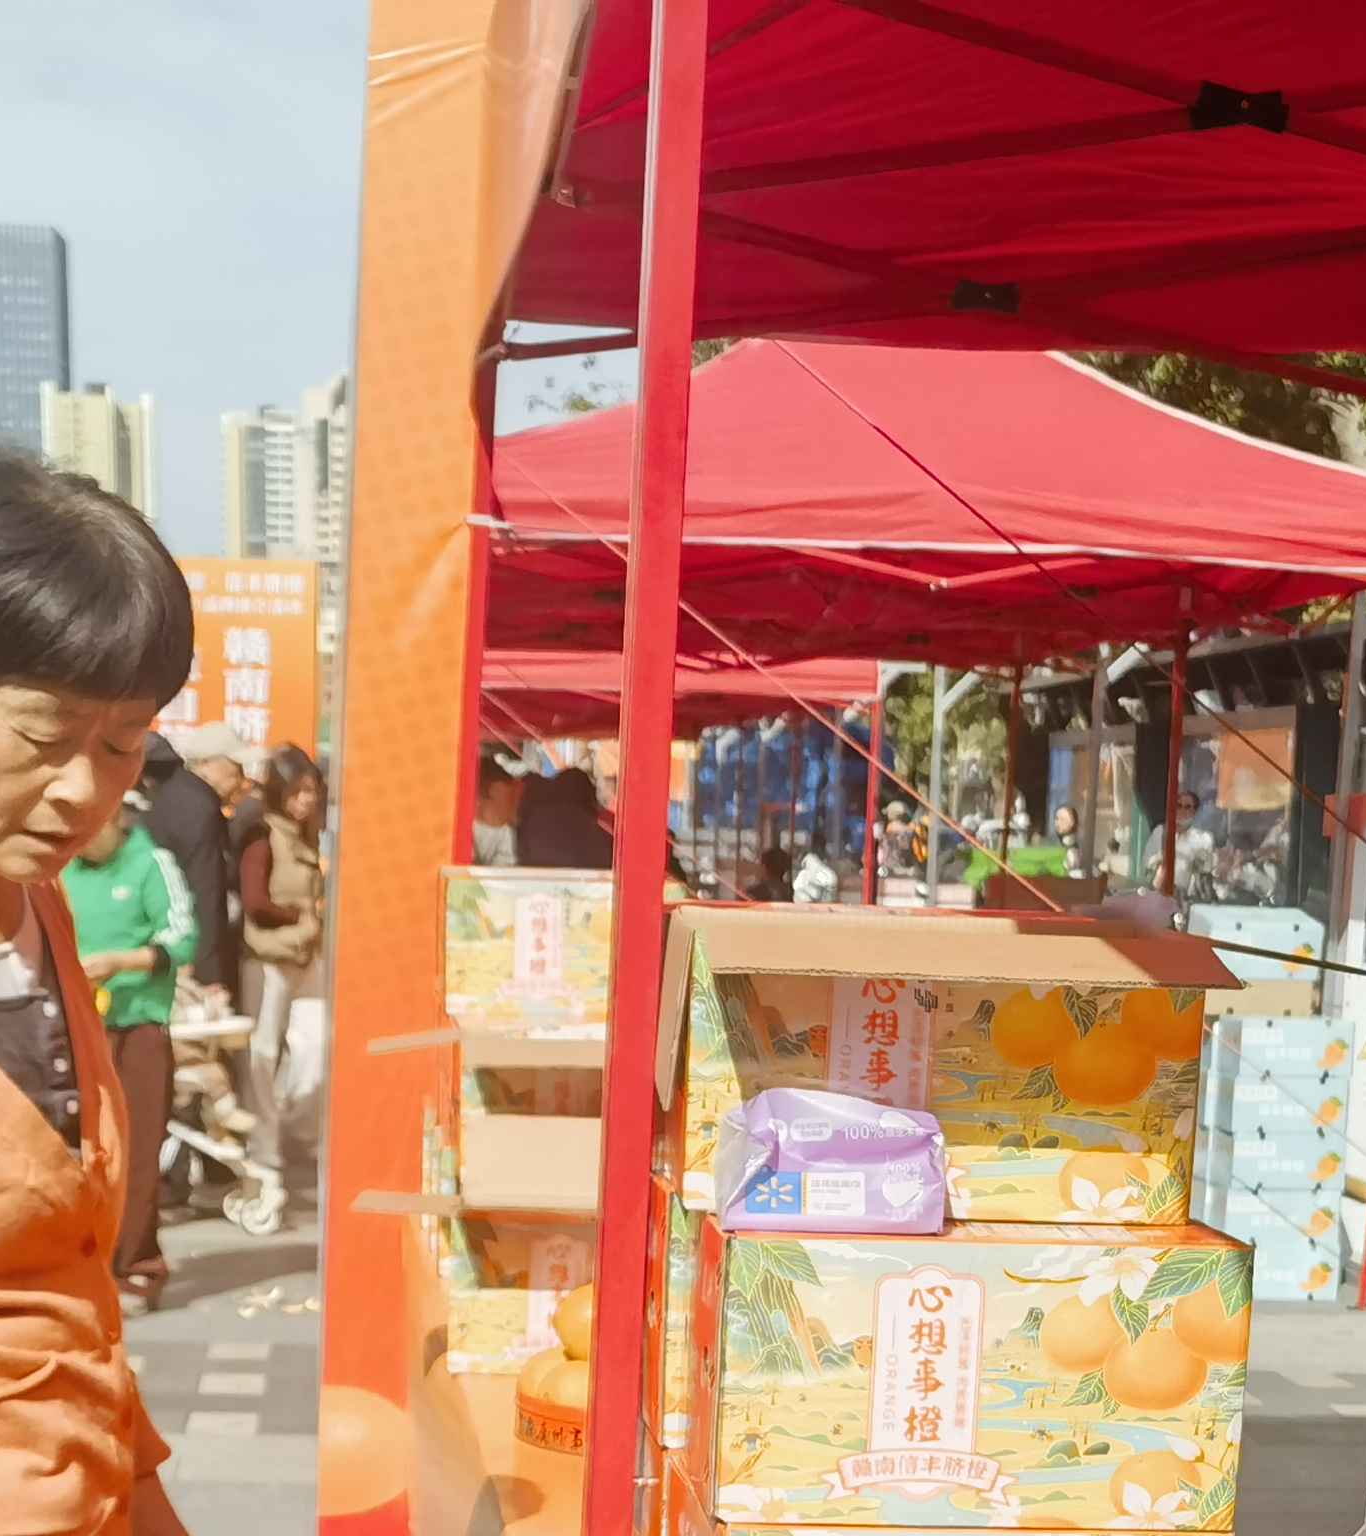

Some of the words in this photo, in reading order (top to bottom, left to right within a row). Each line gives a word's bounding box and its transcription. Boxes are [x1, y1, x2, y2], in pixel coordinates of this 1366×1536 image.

[859, 979, 908, 1103] 心想事
[882, 1353, 898, 1433] ORANGE
[903, 1284, 954, 1443] 心想事橙
